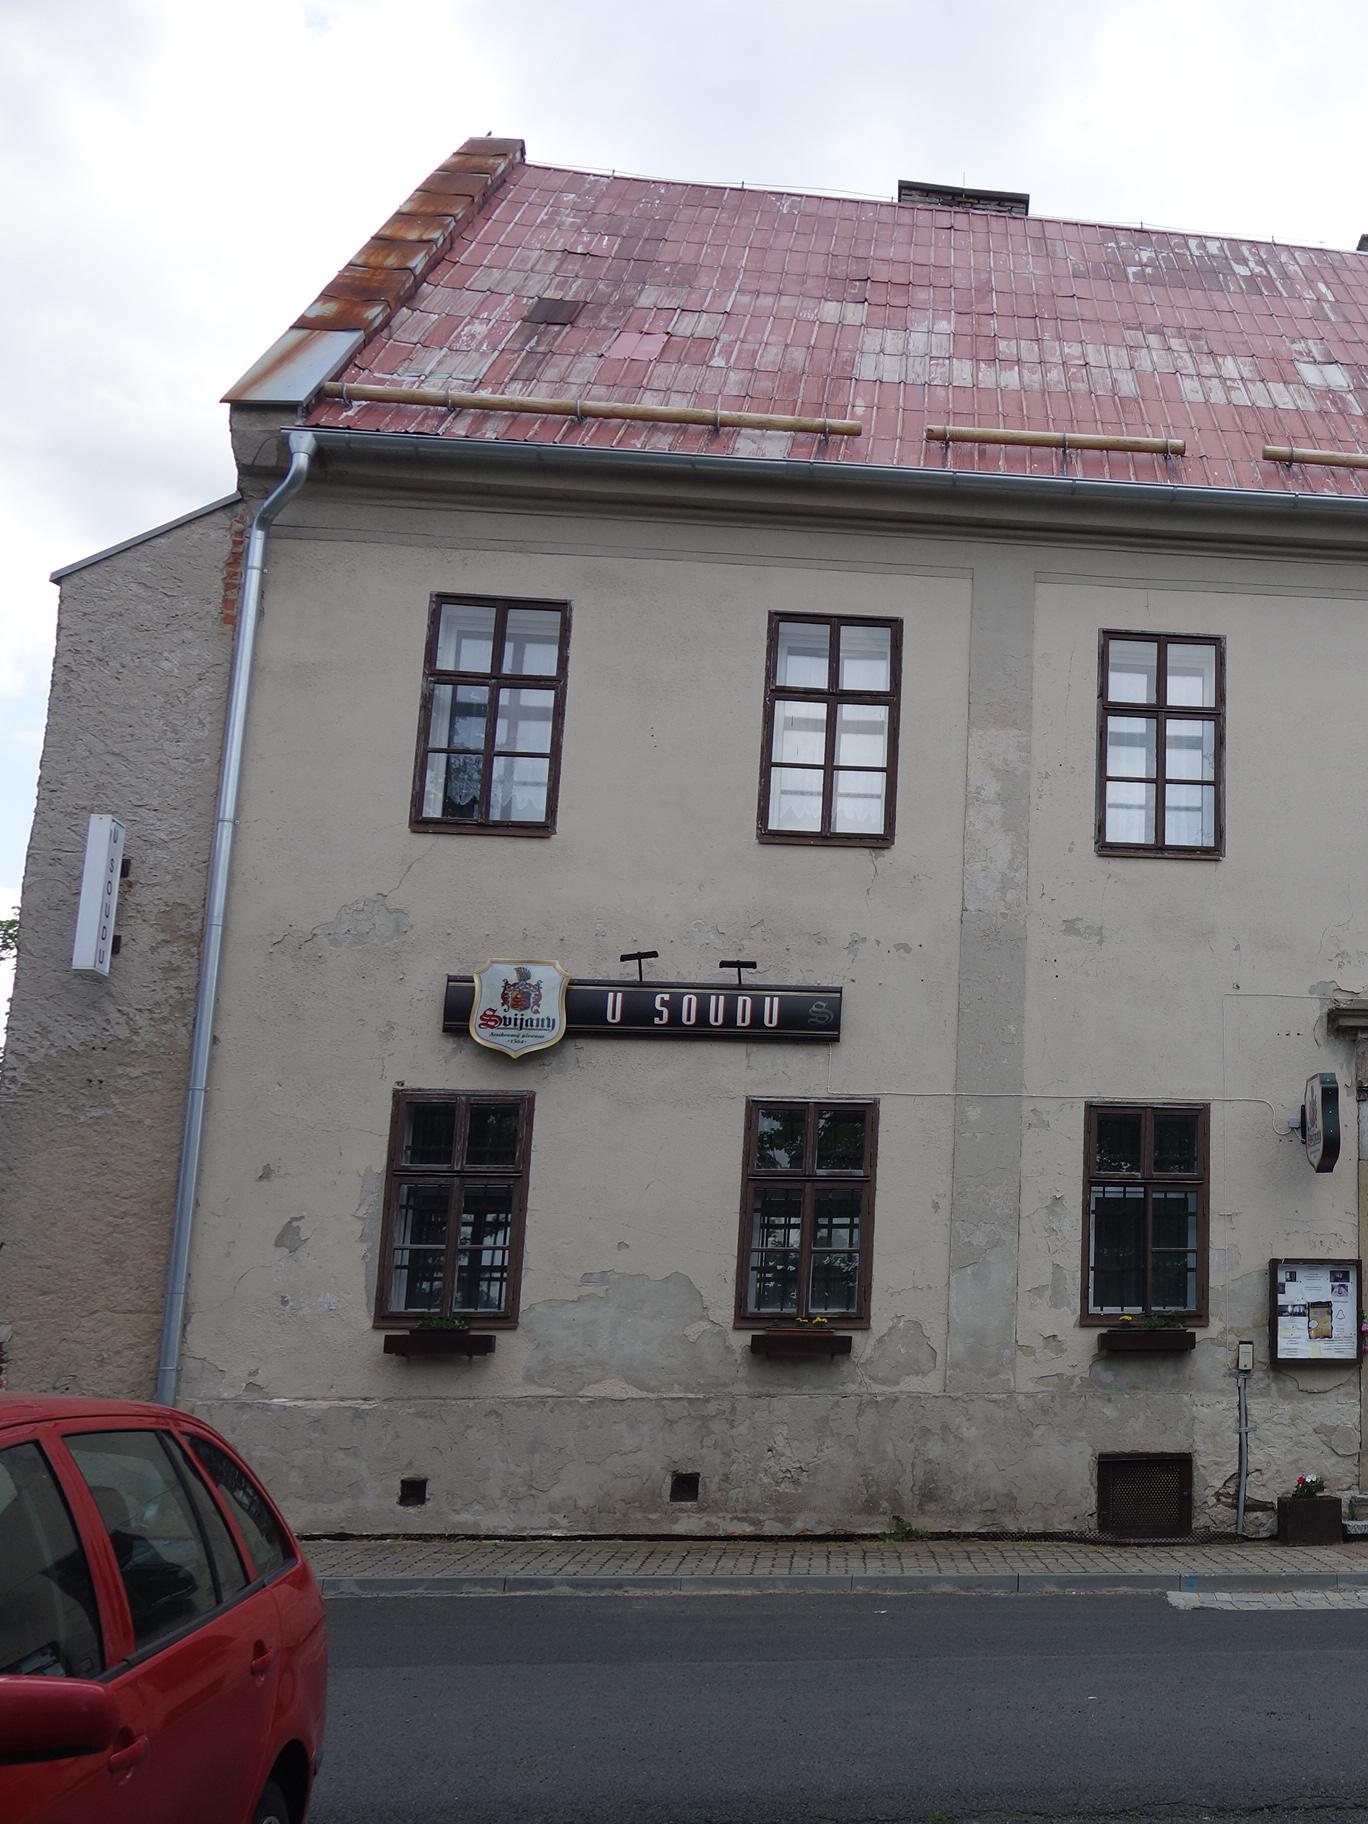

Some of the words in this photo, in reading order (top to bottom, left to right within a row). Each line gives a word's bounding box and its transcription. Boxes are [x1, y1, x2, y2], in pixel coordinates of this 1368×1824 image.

[98, 858, 114, 964] SOUDU
[478, 1008, 556, 1031] Svijany
[606, 992, 622, 1023] U
[654, 993, 780, 1028] SOUDU
[808, 1000, 834, 1024] S
